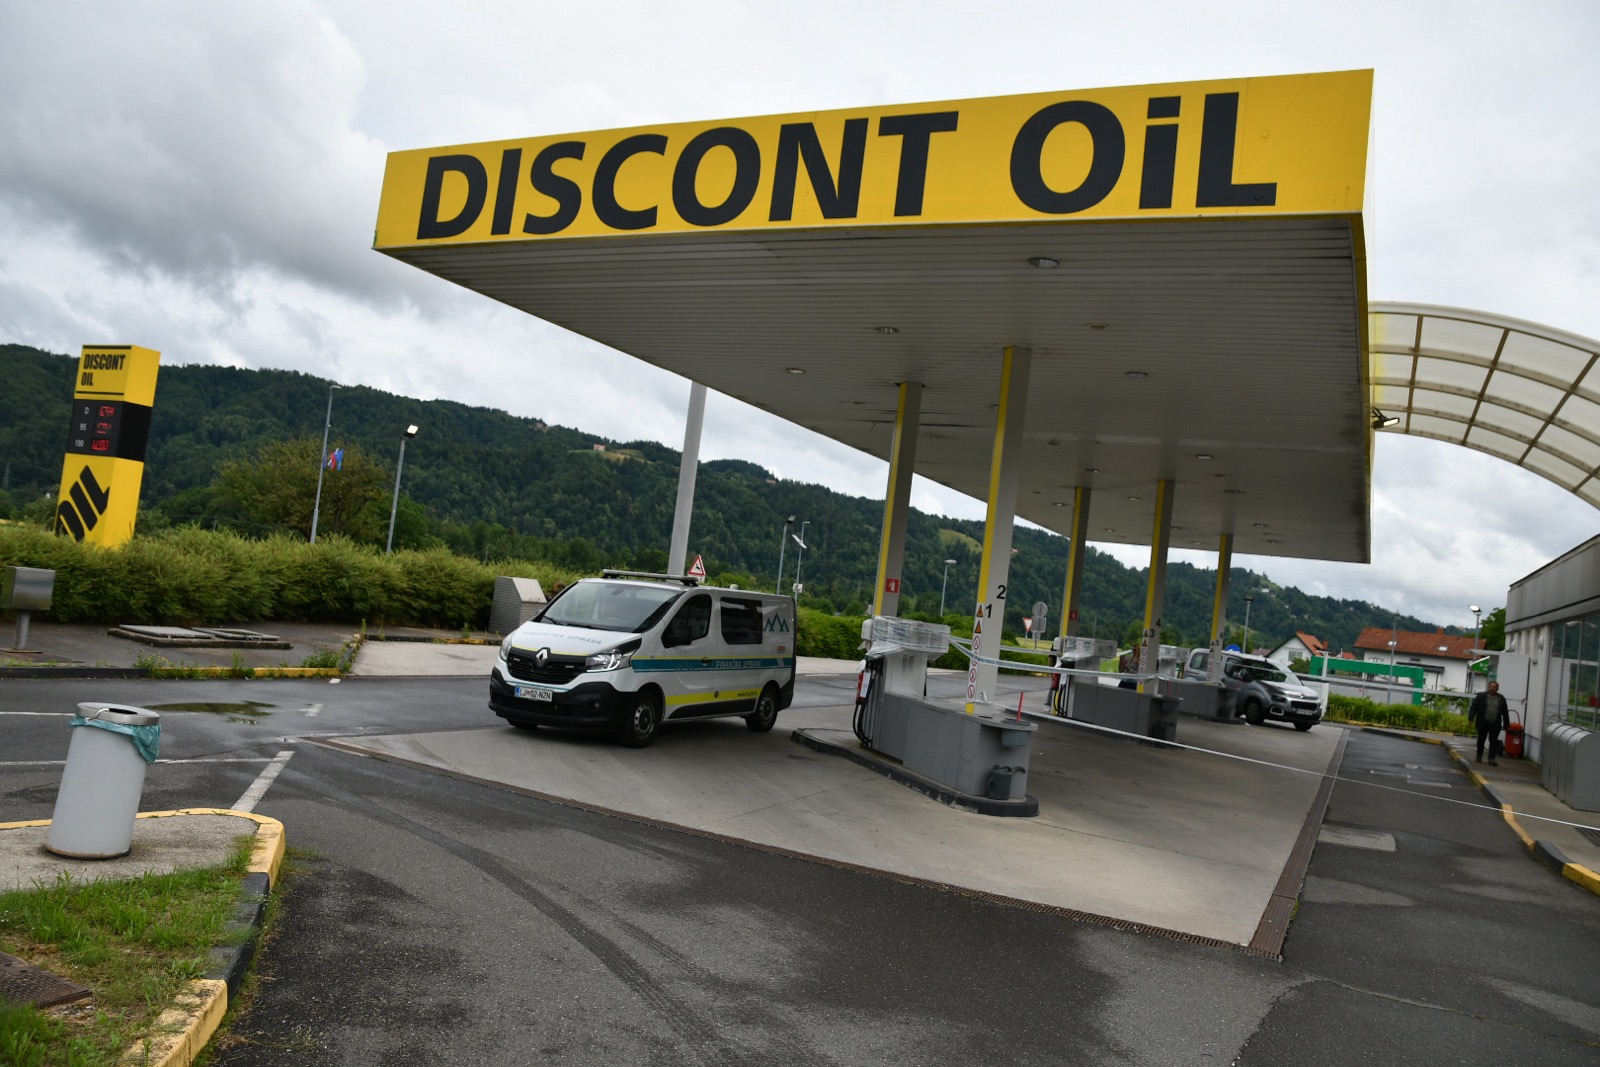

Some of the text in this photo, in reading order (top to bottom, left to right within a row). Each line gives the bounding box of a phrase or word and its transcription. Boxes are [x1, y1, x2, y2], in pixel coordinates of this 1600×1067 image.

[417, 111, 958, 240] DISCONT
[84, 354, 126, 370] DISCONT
[81, 372, 94, 386] OIL
[84, 406, 90, 415] D
[79, 422, 87, 431] 95
[75, 439, 84, 447] 100
[996, 584, 1006, 599] 2
[986, 604, 992, 618] 1
[1156, 618, 1161, 627] 4
[1150, 629, 1155, 638] 3
[568, 636, 602, 644] UPRAVA
